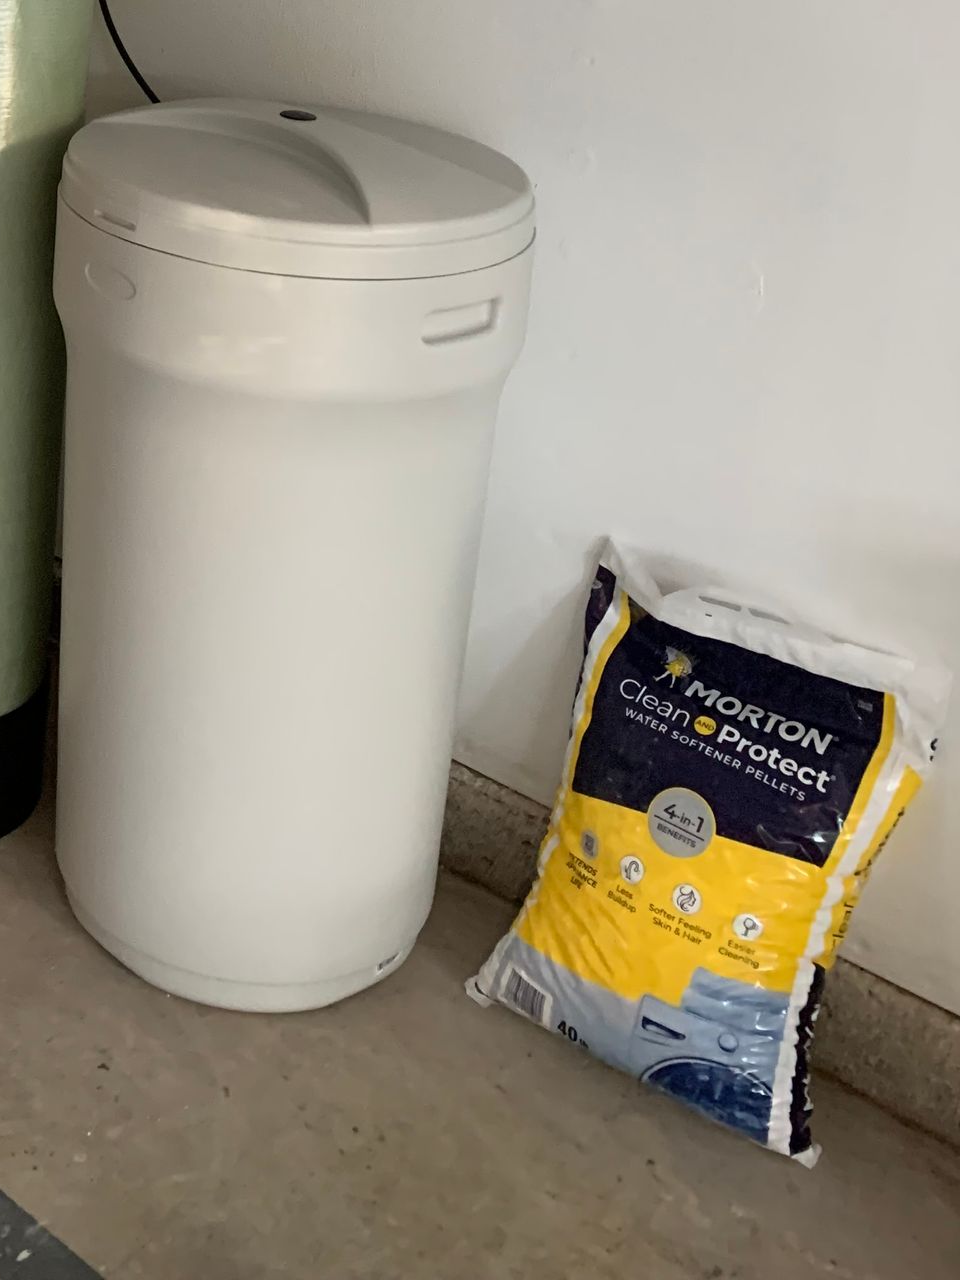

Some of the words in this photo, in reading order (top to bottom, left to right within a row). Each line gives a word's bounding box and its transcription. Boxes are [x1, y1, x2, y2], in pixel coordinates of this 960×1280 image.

[684, 680, 834, 755] MORTON
[619, 678, 691, 728] Clean
[694, 719, 715, 732] AND
[716, 724, 830, 793] Protect
[625, 707, 668, 734] WATER
[671, 729, 741, 770] SOFTENER
[745, 765, 806, 802] PELLETS
[663, 803, 705, 833] 4-in-1
[656, 823, 697, 849] BENEFITS
[607, 890, 637, 913] Buildup
[616, 885, 634, 900] Less
[648, 903, 676, 922] Softer
[678, 917, 712, 940] Feeling
[652, 917, 672, 932] Skin
[674, 927, 680, 936] &
[682, 929, 702, 945] Hair
[718, 946, 760, 969] Cleaning
[727, 939, 756, 956] Easier
[557, 1020, 578, 1041] 40
